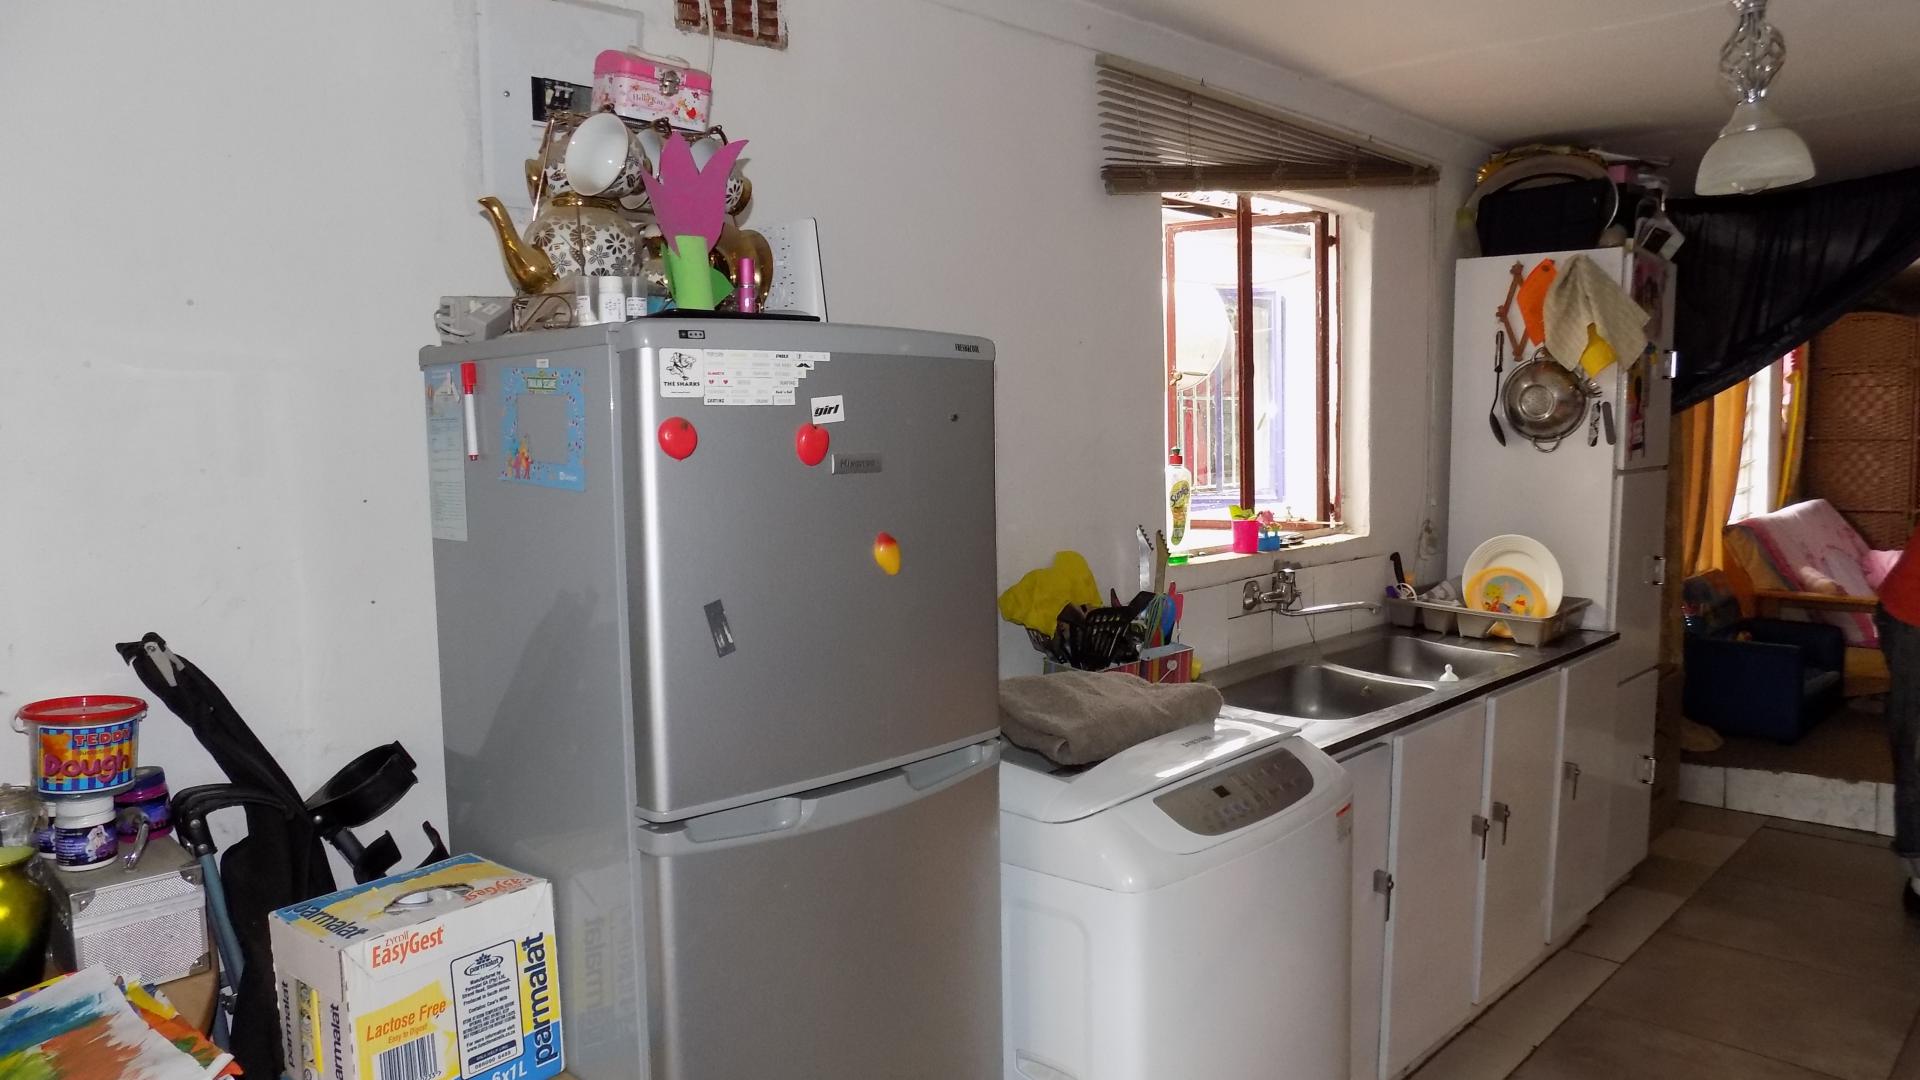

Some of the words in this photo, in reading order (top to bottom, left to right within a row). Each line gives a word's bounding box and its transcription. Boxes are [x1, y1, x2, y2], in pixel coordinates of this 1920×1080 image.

[814, 404, 840, 417] girl
[74, 729, 131, 748] TEDDY
[44, 747, 131, 783] Dough
[372, 926, 444, 969] EasyGest
[469, 957, 498, 974] parmalat
[520, 931, 560, 1066] parmalat
[281, 981, 296, 1068] parmalat
[330, 1002, 344, 1080] armalat
[366, 1011, 416, 1042] Lactose
[419, 1000, 447, 1022] Free
